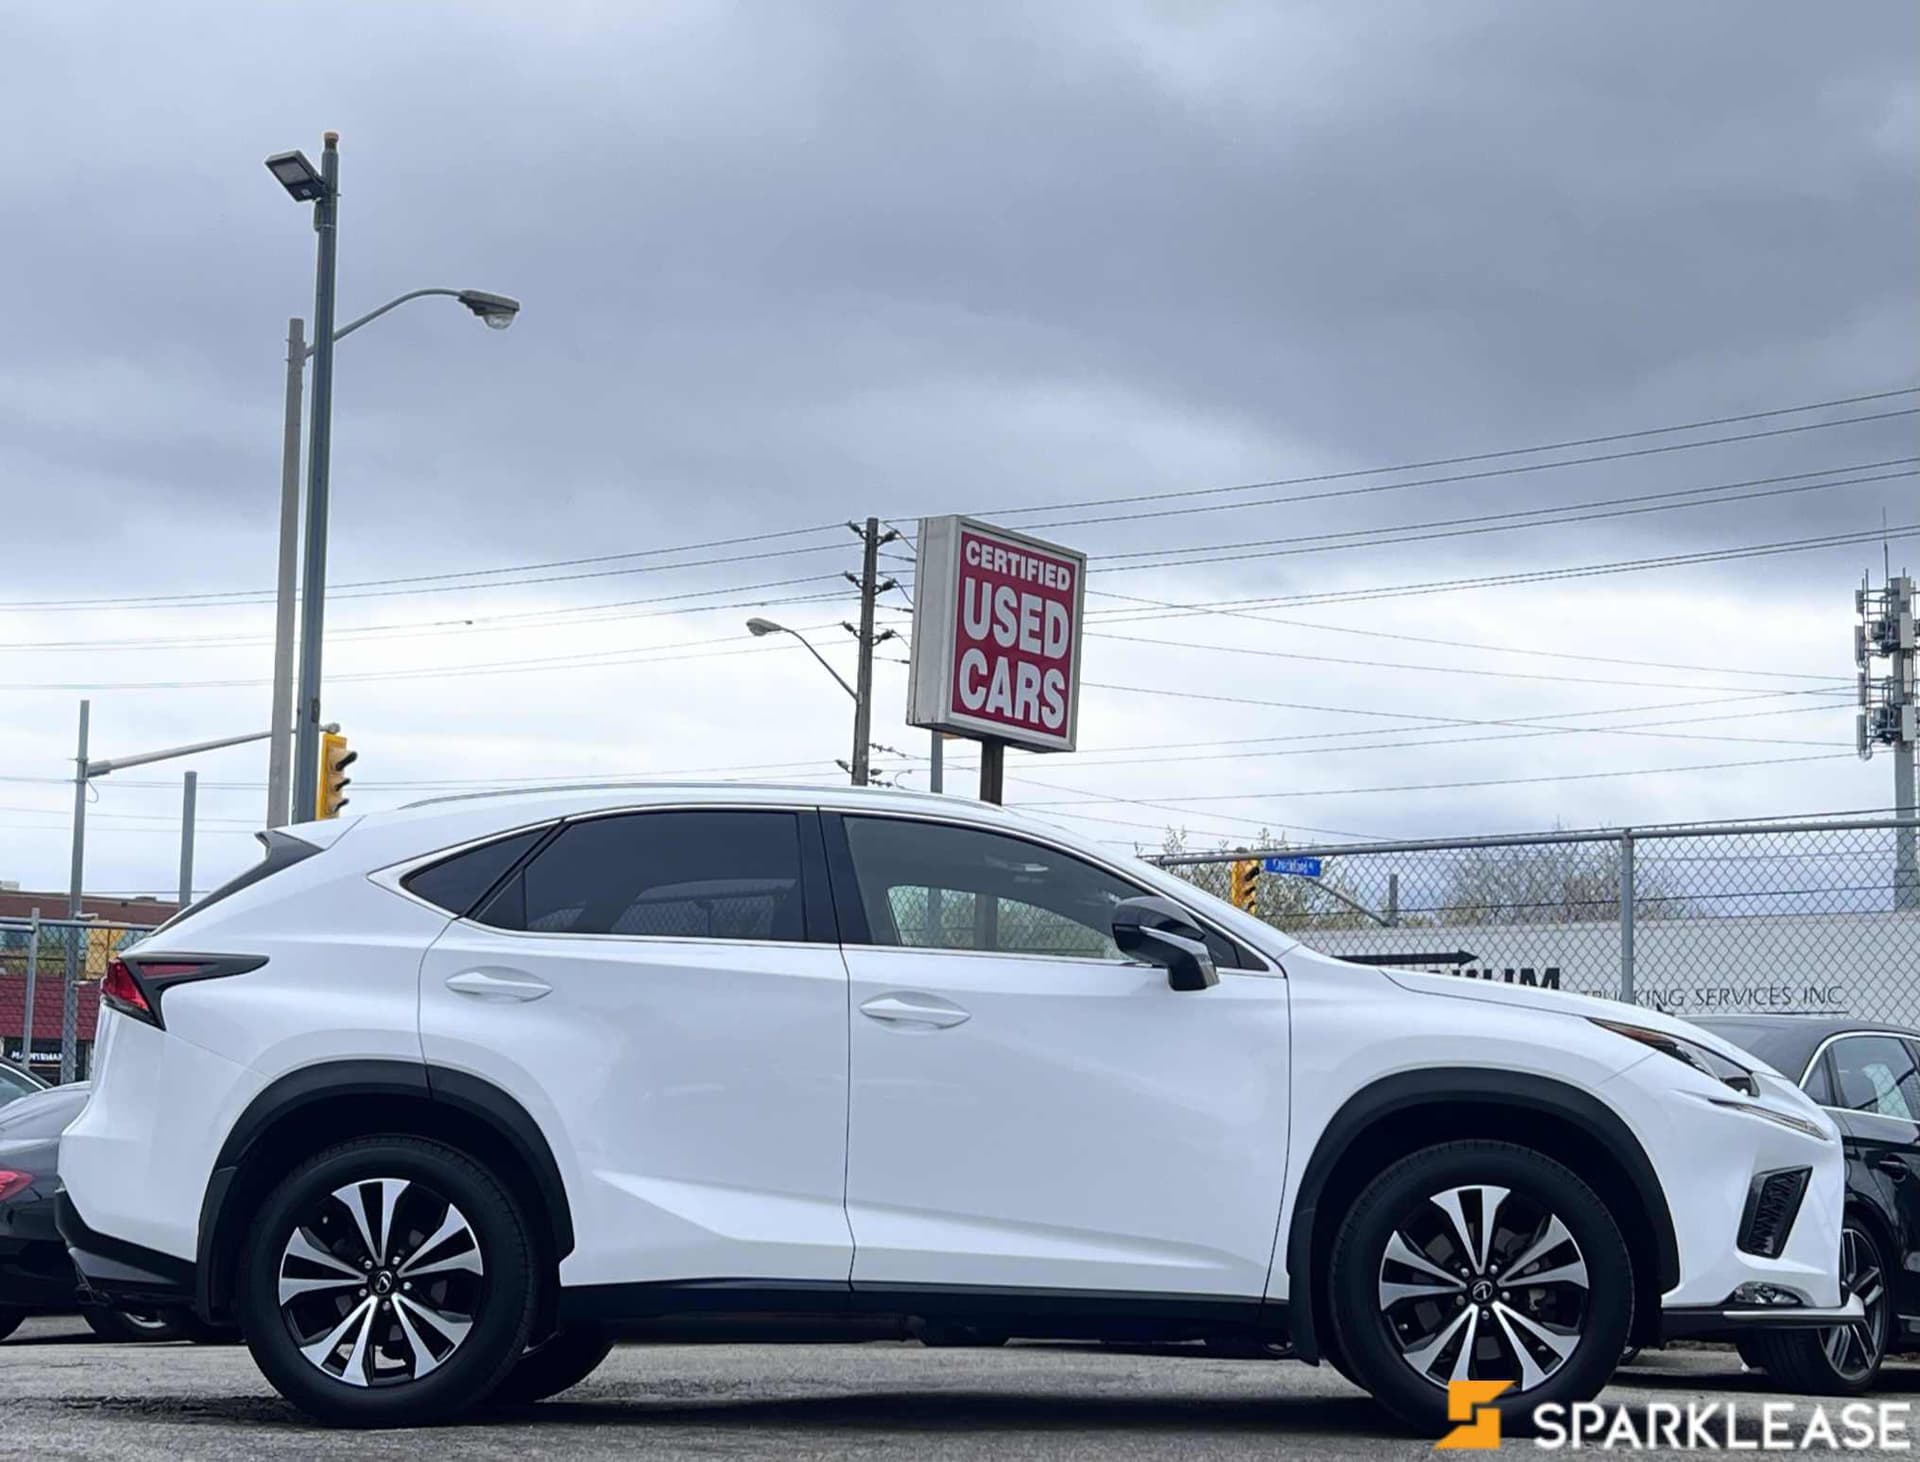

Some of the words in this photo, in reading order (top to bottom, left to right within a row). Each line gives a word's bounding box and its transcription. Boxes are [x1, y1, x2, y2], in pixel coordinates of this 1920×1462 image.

[965, 540, 1071, 591] CERTIFIED
[963, 577, 1069, 660] USED
[959, 648, 1066, 729] CARS
[1695, 984, 1792, 1006] SERVICES
